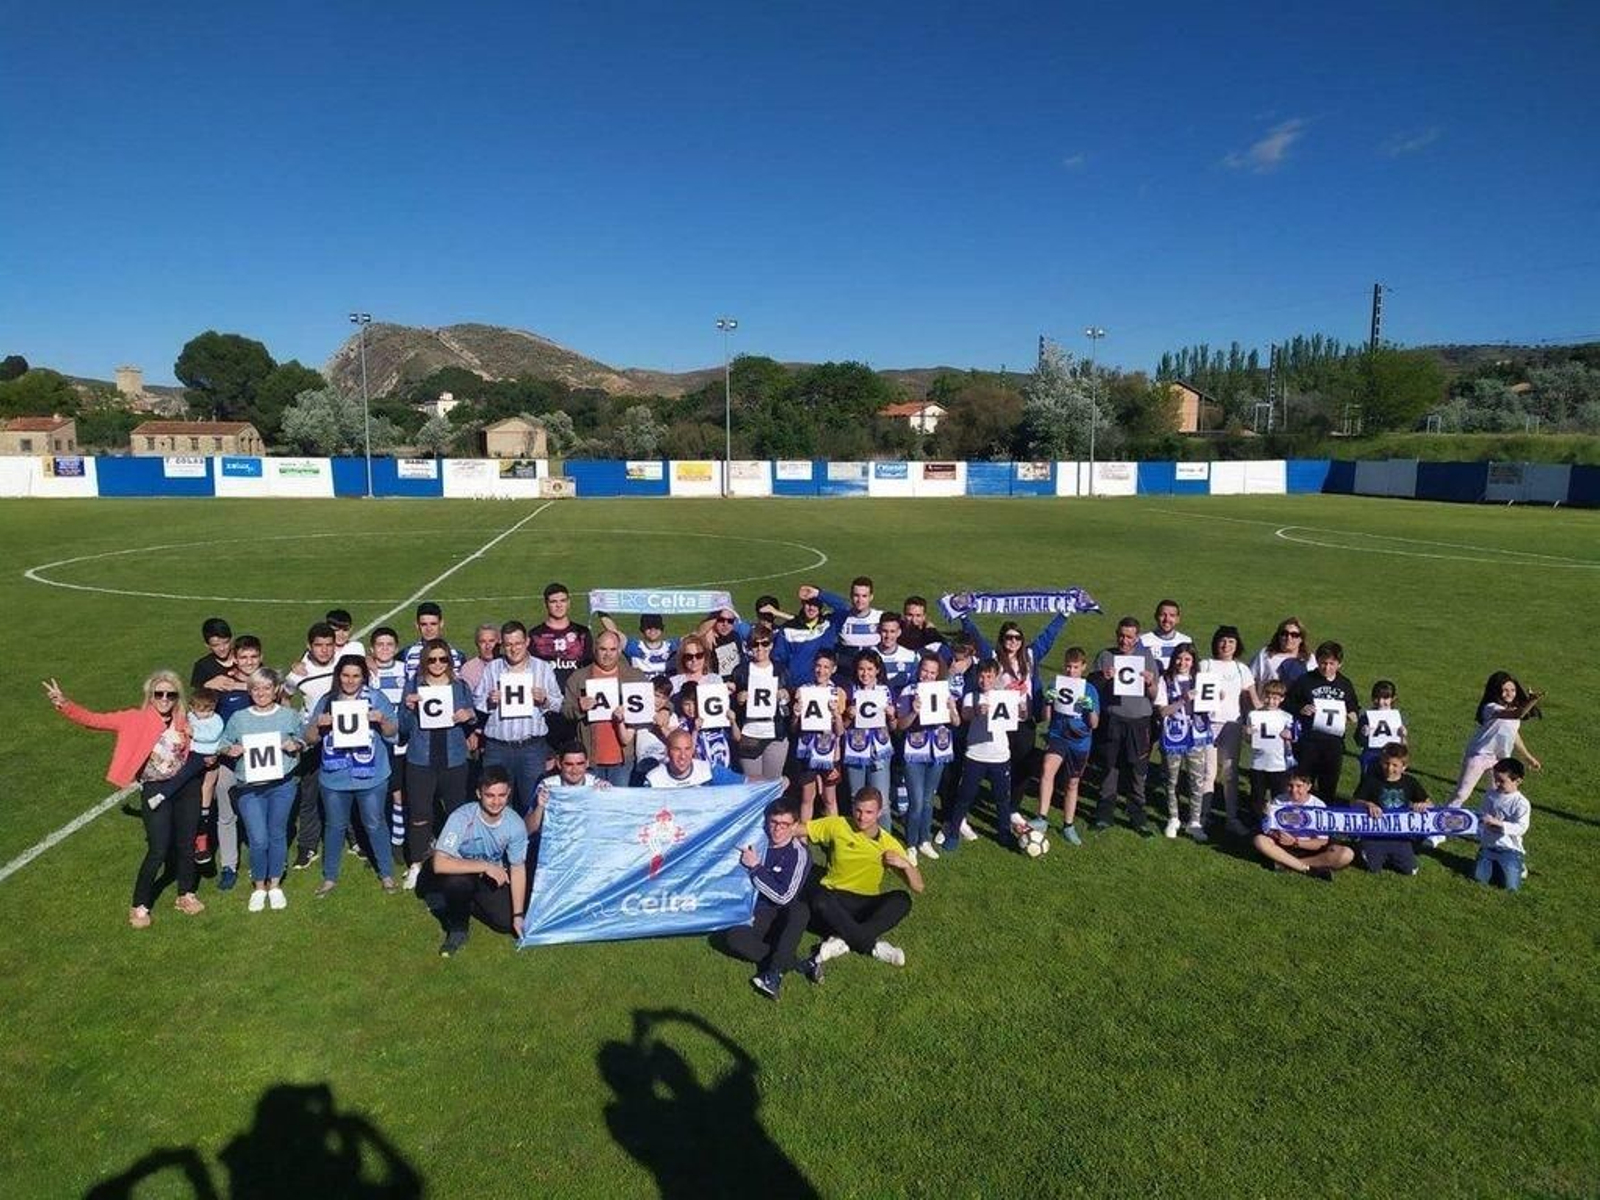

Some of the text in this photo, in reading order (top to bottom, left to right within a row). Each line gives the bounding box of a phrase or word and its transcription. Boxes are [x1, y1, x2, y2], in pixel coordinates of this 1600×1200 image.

[647, 593, 696, 608] Celta
[1003, 597, 1050, 612] ALHAMA
[1119, 667, 1135, 684] C
[505, 686, 524, 704] H
[592, 692, 611, 710] A
[753, 688, 771, 706] R
[1058, 688, 1074, 705] S
[1201, 684, 1215, 700] E
[423, 698, 442, 717] C
[627, 695, 645, 713] S
[704, 697, 724, 716] G
[804, 700, 823, 718] A
[859, 701, 877, 718] C
[930, 693, 938, 712] I
[991, 703, 1010, 720] A
[338, 714, 359, 735] U
[1322, 709, 1340, 727] T
[1260, 723, 1276, 739] L
[1373, 720, 1392, 738] A
[249, 746, 276, 769] M
[1343, 812, 1401, 832] ALHAMA
[621, 887, 697, 915] Celta
